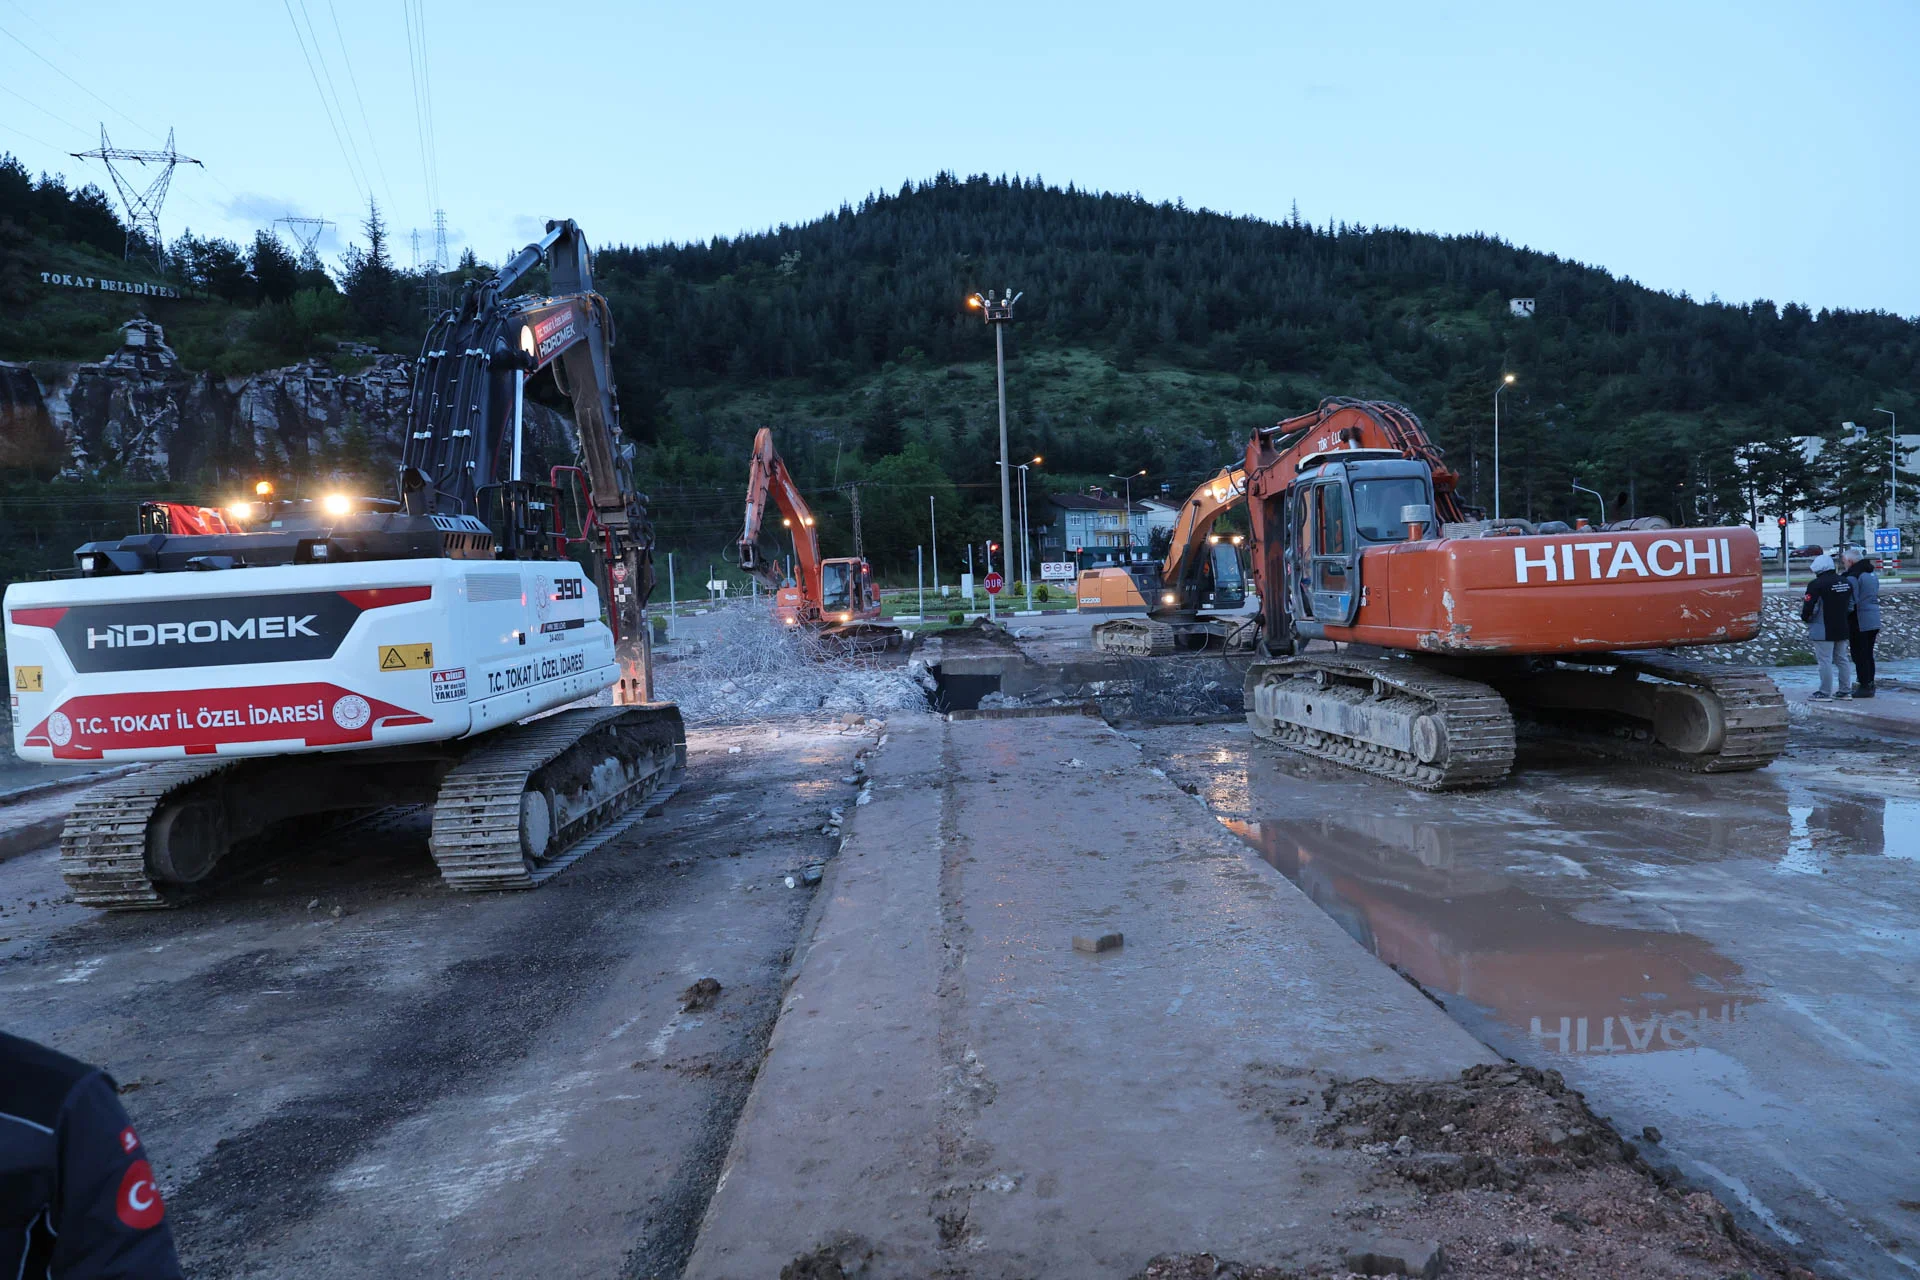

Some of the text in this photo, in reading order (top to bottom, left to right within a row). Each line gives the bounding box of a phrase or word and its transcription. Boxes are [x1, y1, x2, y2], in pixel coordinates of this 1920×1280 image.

[41, 272, 95, 288] TOKAT
[1216, 476, 1246, 504] CAS
[1514, 538, 1731, 583] HITACHI
[554, 578, 583, 600] 390
[985, 579, 1003, 588] DUR
[488, 648, 585, 693] T.C. TOKAT İL ÖZEL İDARESİ
[76, 699, 325, 735] T.C. TOKAT İL ÖZEL İDARESİ
